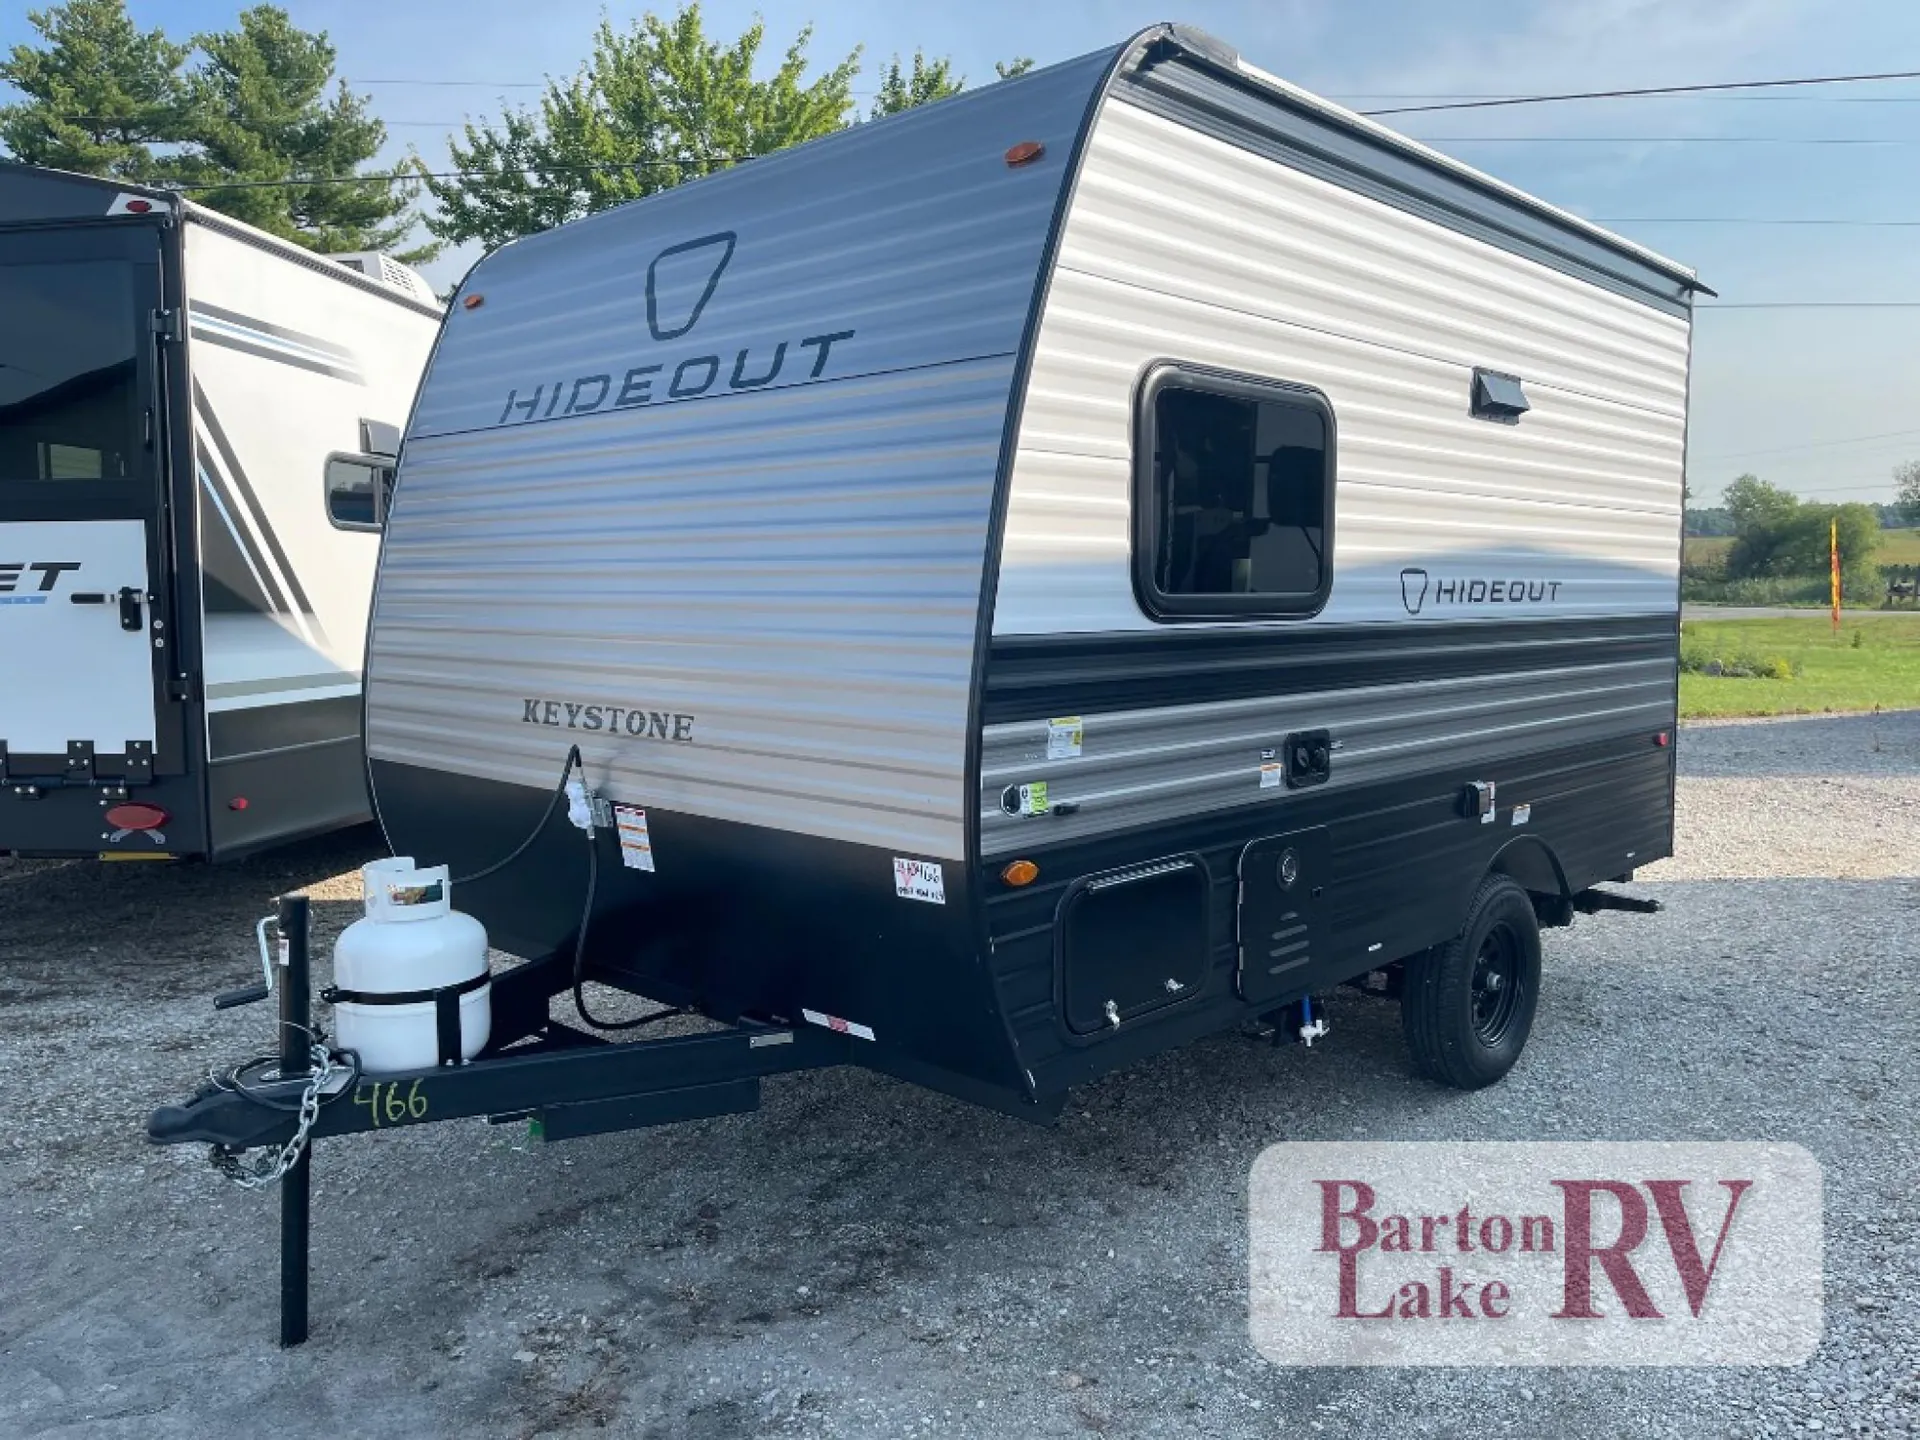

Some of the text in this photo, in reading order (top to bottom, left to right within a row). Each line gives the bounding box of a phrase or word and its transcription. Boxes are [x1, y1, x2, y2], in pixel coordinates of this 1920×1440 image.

[499, 330, 856, 424] HIDEOUT
[1436, 579, 1563, 605] HIDEOUT
[522, 698, 695, 742] KEYSTONE
[354, 1078, 428, 1127] 466
